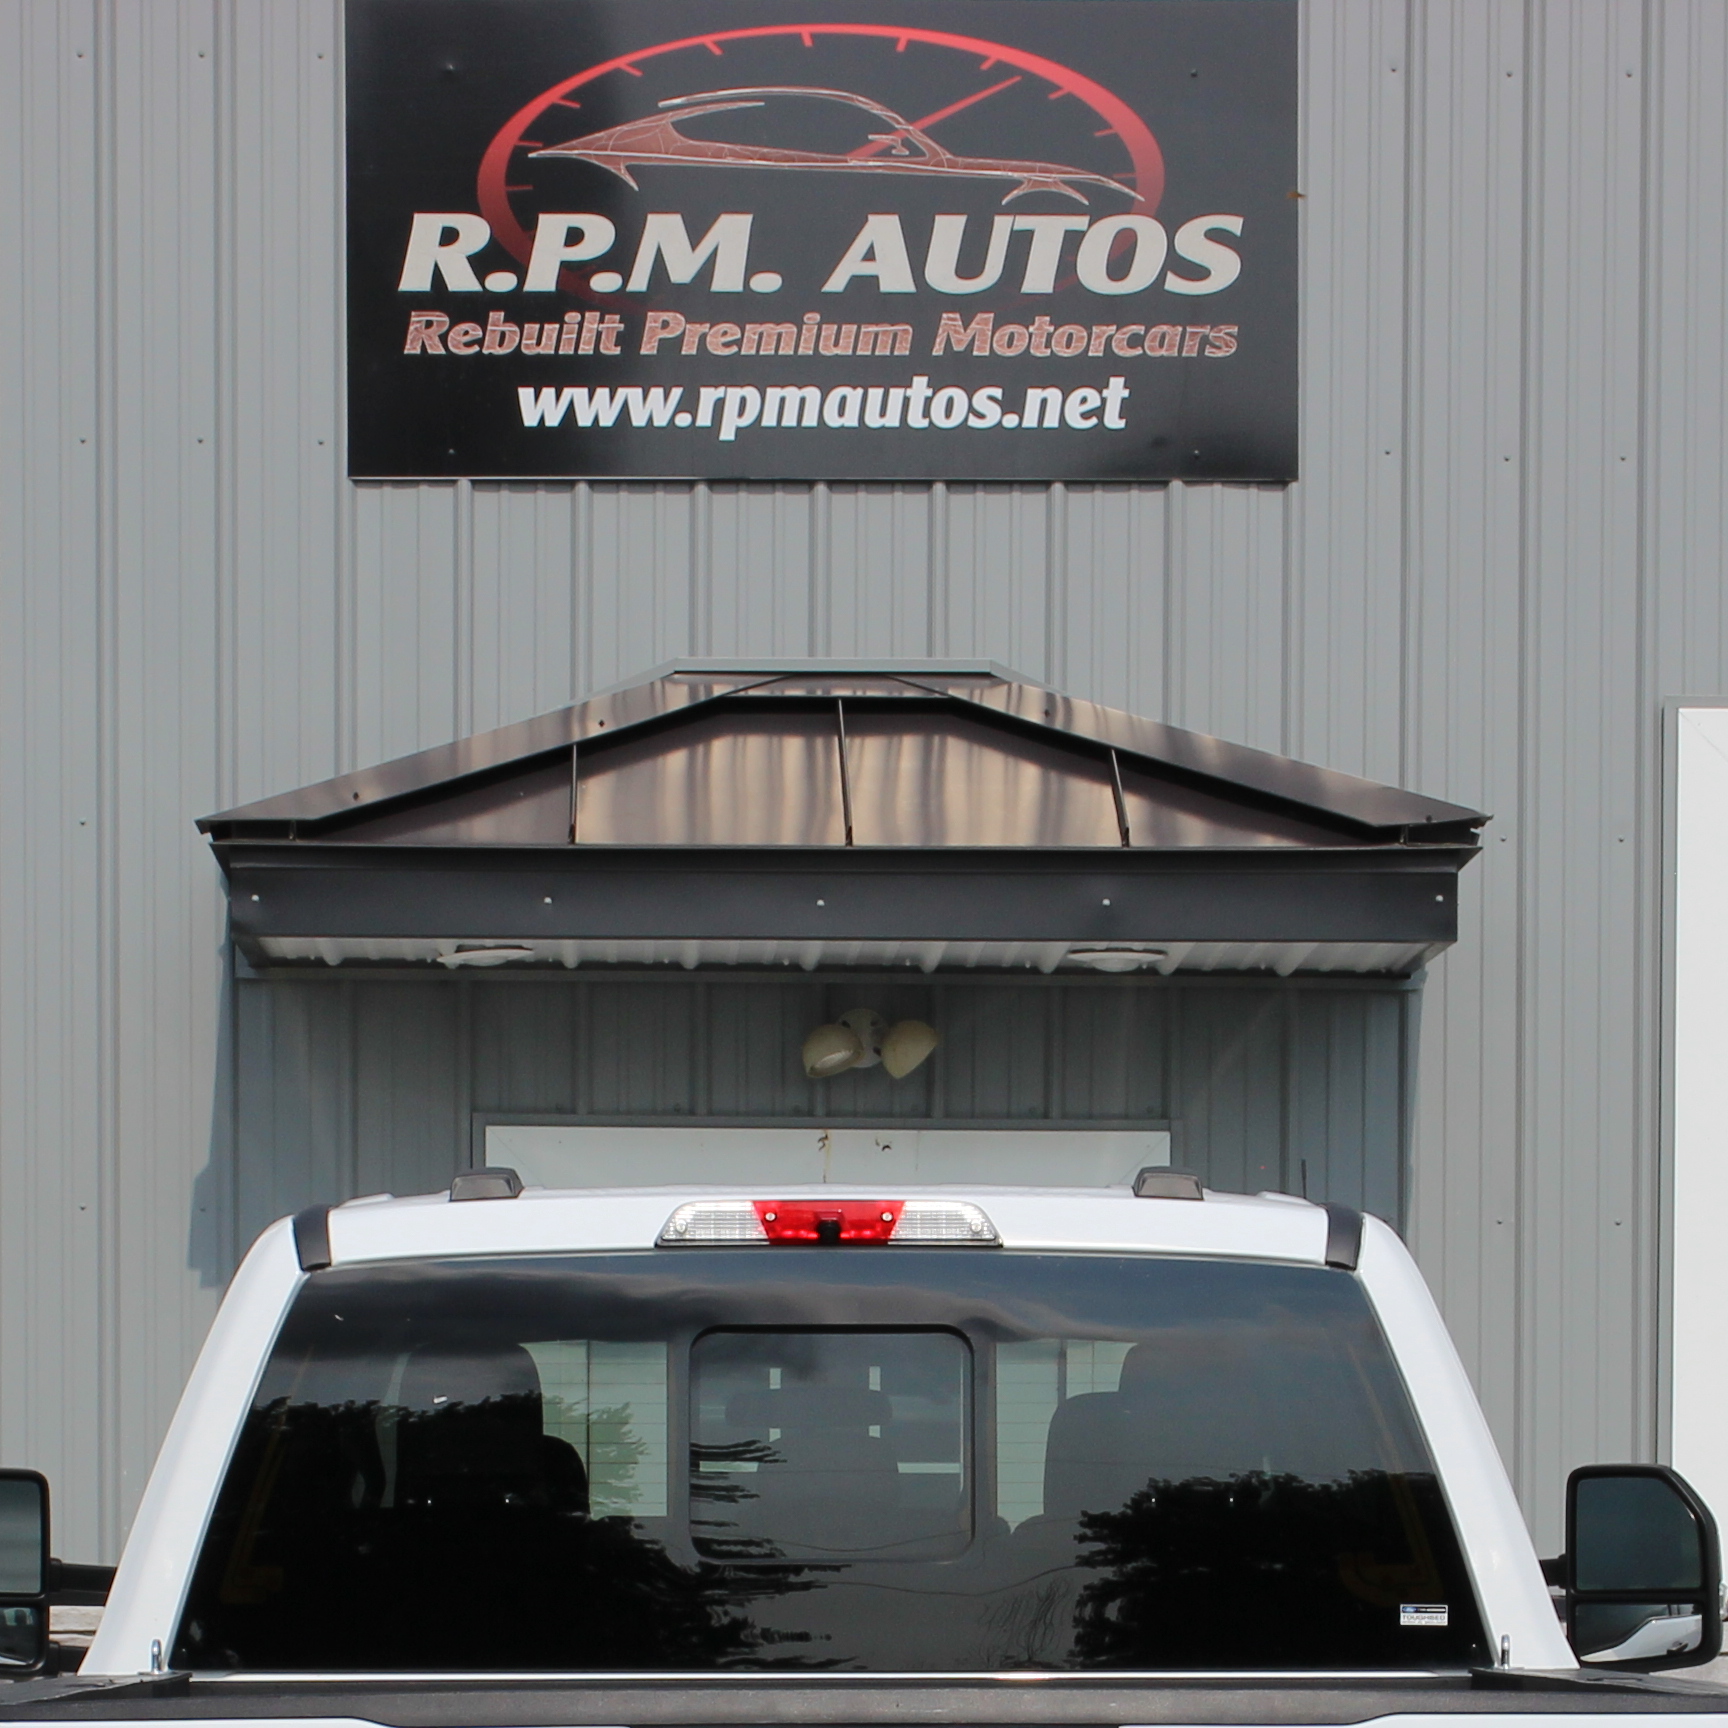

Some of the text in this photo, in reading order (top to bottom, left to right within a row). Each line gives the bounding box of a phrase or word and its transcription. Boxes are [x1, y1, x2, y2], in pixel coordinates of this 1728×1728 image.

[398, 212, 1244, 296] R.P.M. AUTOS
[403, 310, 1239, 358] Rebuilt Premium Motorcars
[517, 374, 1130, 442] www.rpmautos.net
